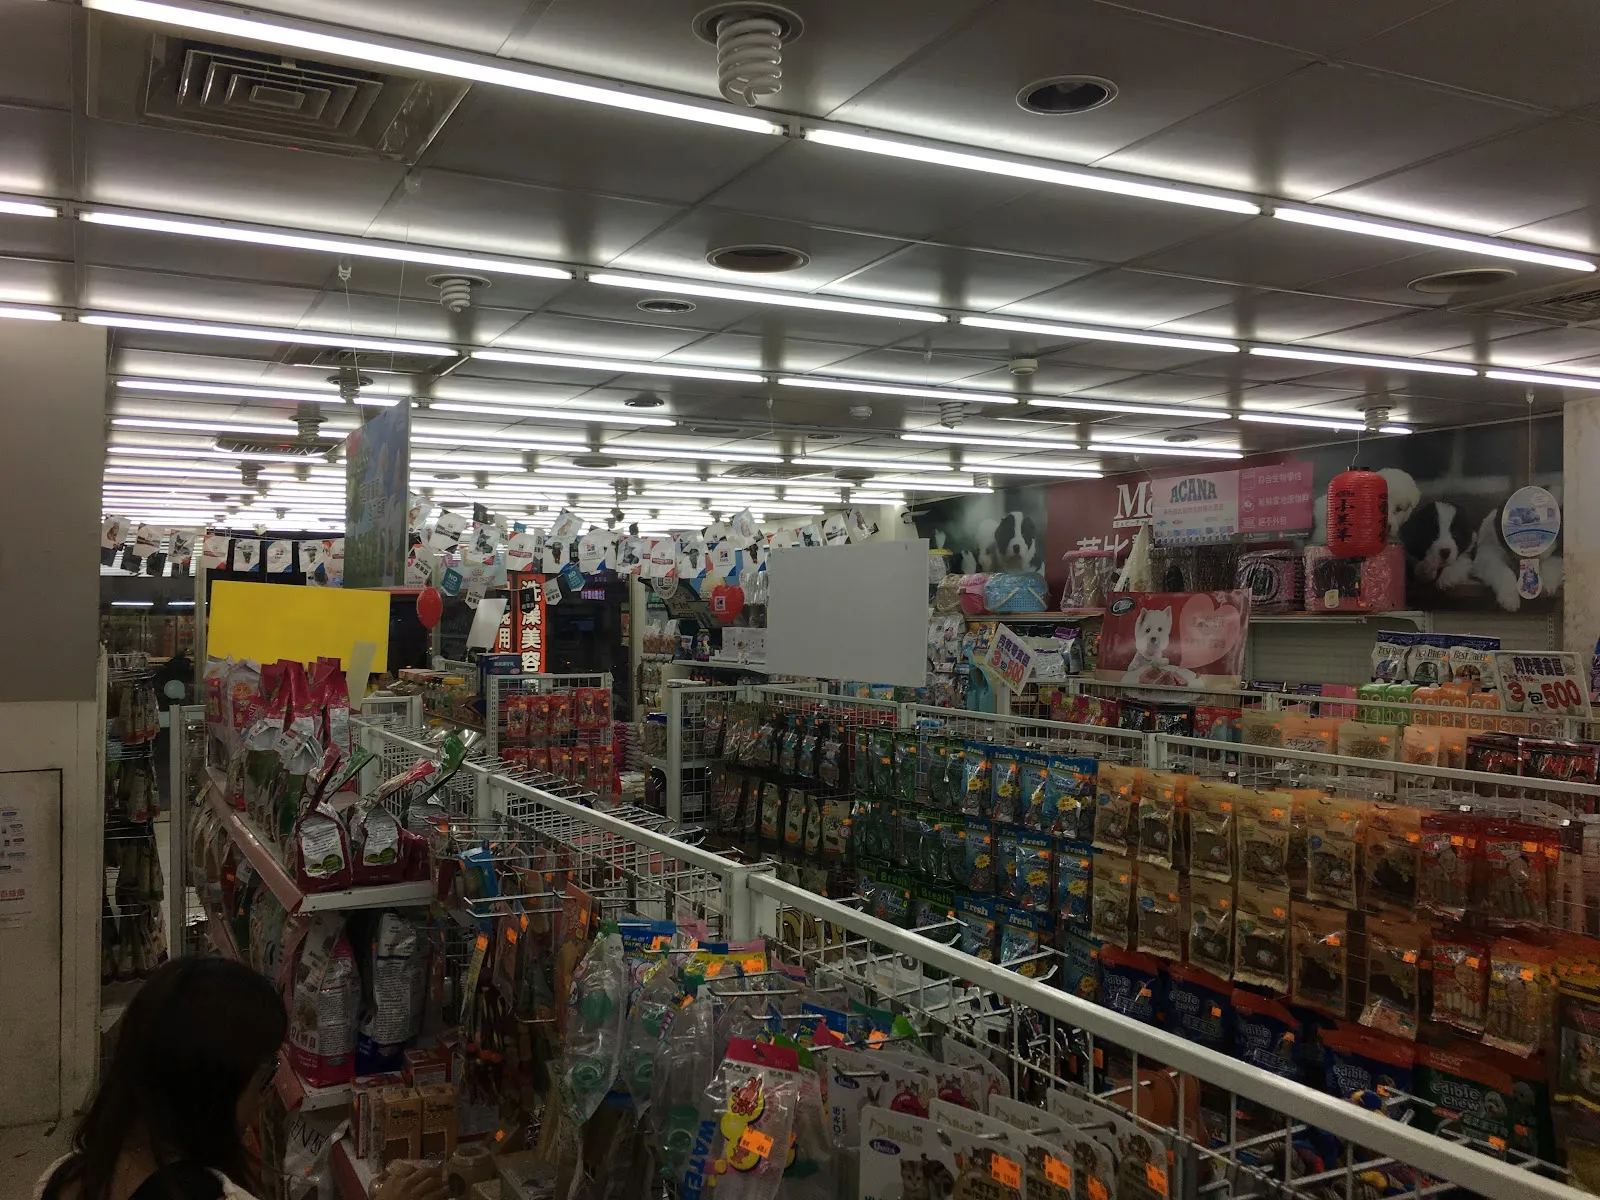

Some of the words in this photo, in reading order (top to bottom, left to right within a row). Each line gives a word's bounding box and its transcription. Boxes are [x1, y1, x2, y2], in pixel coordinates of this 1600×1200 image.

[1169, 477, 1218, 503] ACANA
[448, 573, 458, 582] NO
[1054, 761, 1081, 772] Fresh
[1021, 836, 1048, 847] Fresh
[1064, 845, 1088, 855] Fresh
[921, 886, 953, 906] Breath
[963, 901, 989, 917] Fresh
[1008, 913, 1033, 928] Fresh
[1169, 990, 1200, 1005] edible
[1333, 1064, 1371, 1081] edible
[1430, 1081, 1481, 1101] edible
[1442, 1094, 1480, 1111] chew
